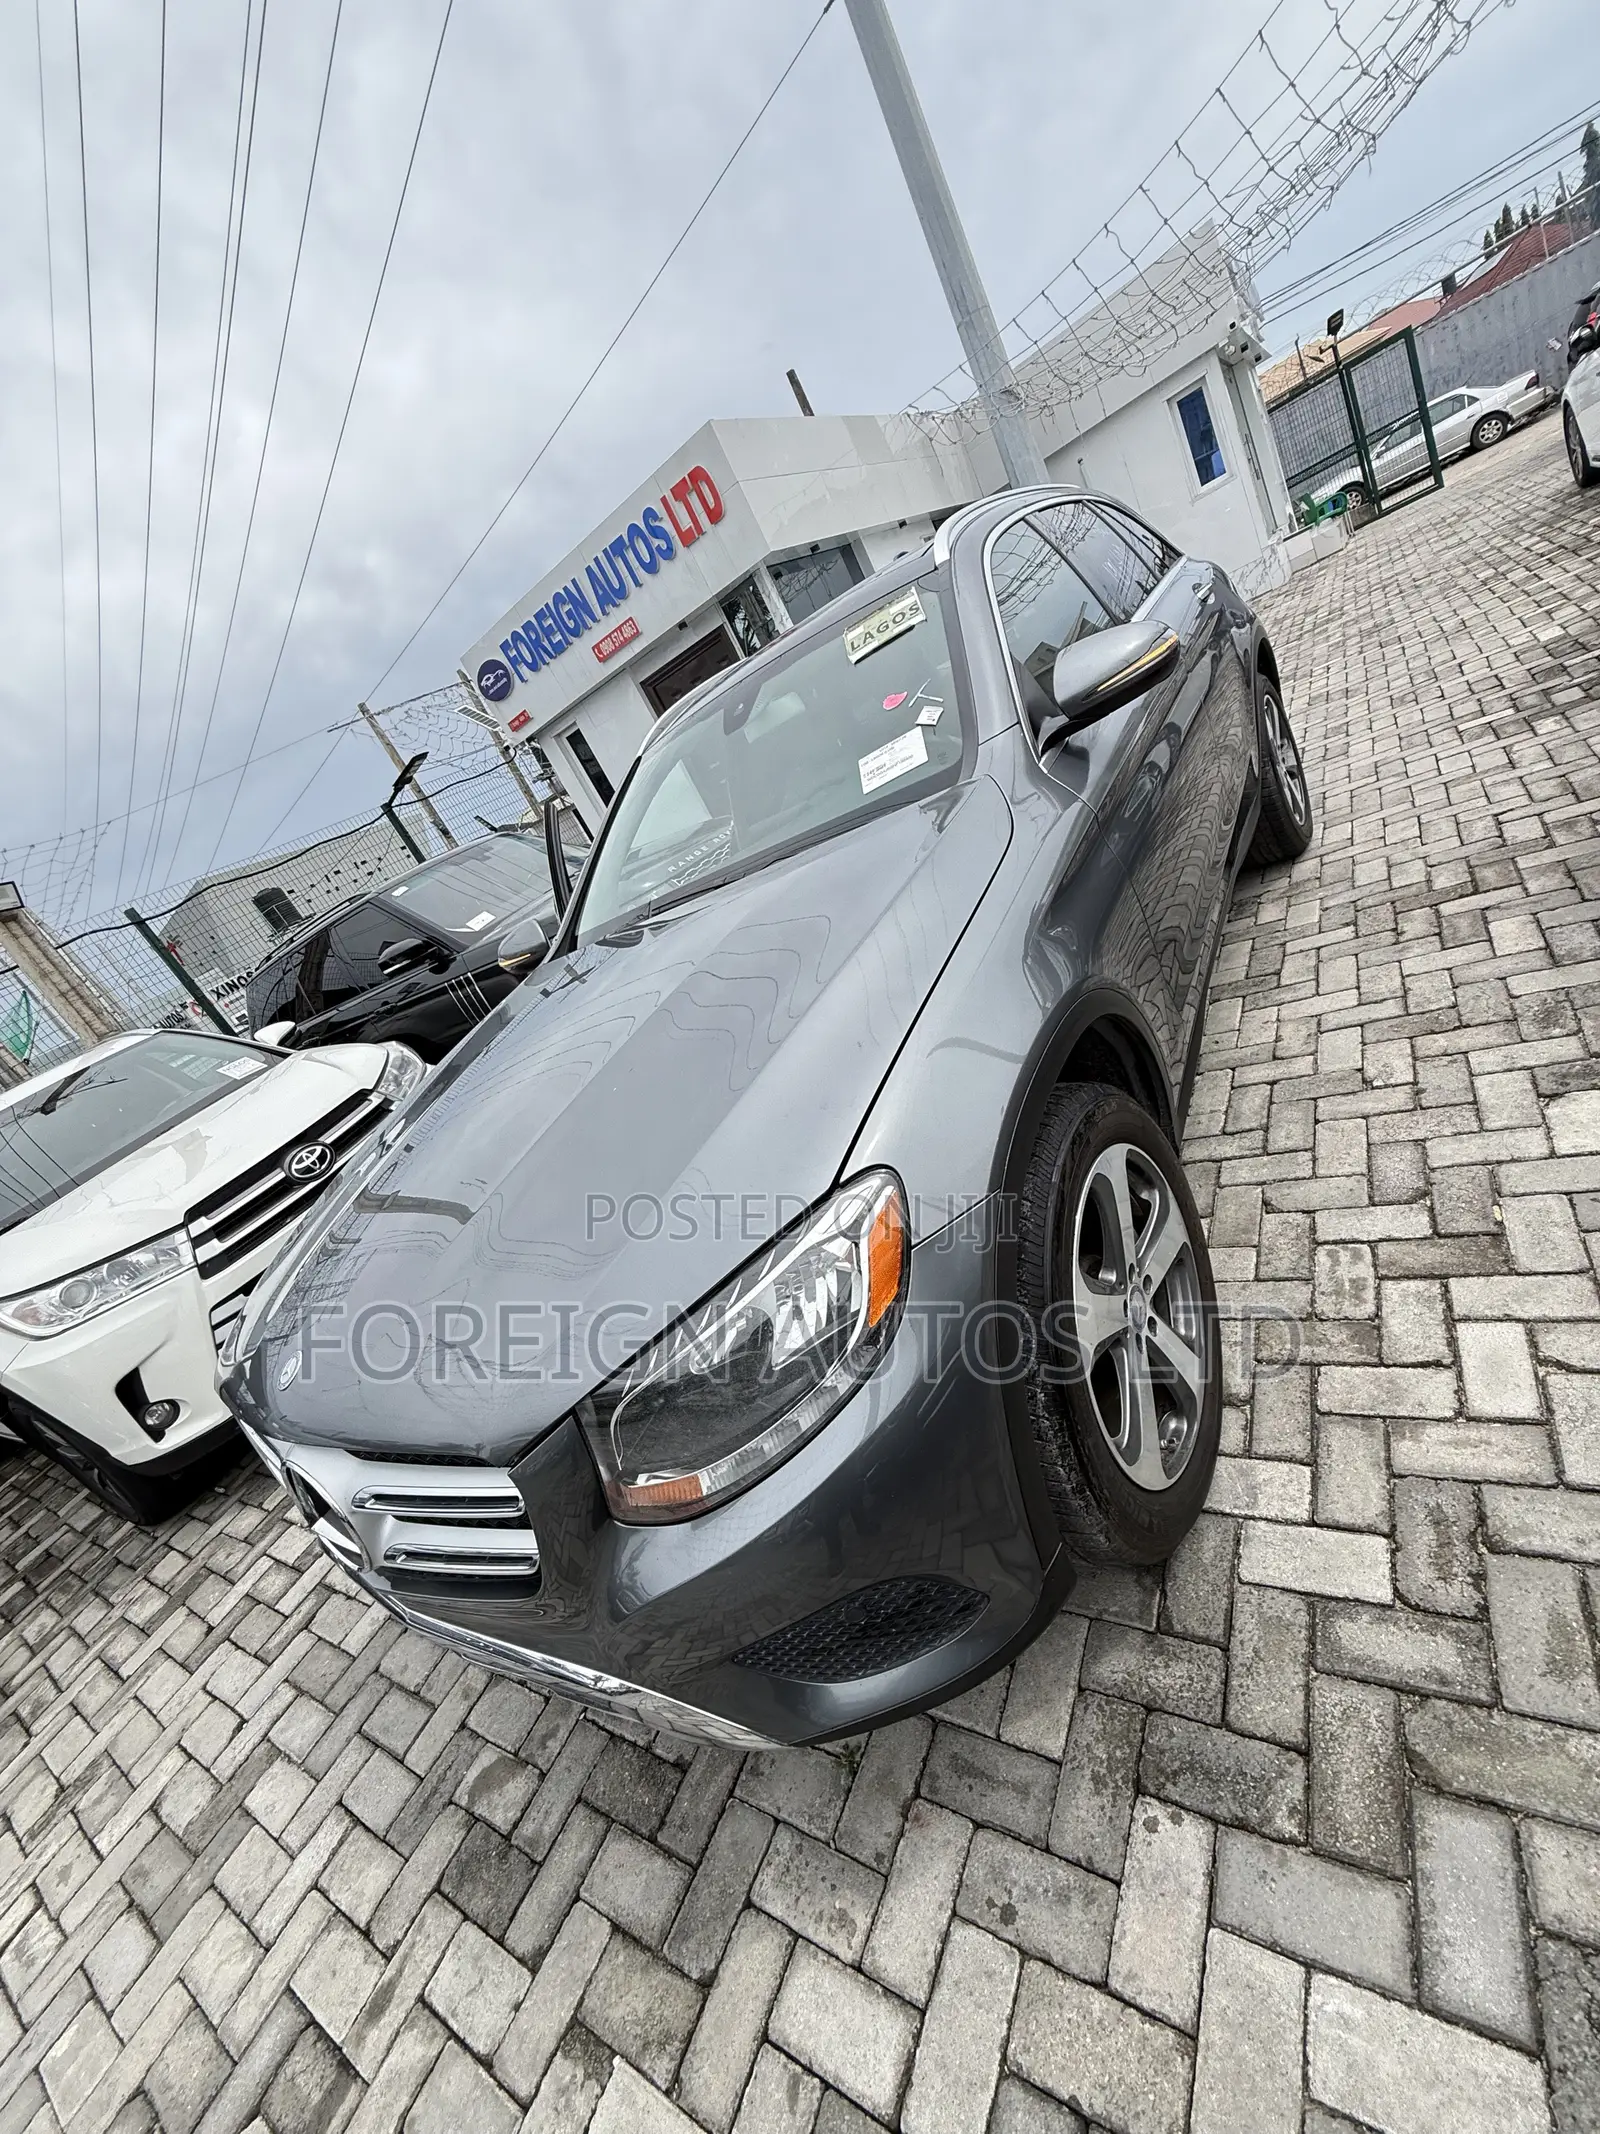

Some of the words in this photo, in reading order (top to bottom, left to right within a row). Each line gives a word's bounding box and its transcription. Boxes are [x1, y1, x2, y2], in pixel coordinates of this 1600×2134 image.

[500, 577, 600, 684] FOREIGN
[585, 506, 677, 617] AUTOS
[660, 465, 725, 548] LTD
[850, 602, 920, 652] LAGOS
[667, 845, 709, 873] RANGE
